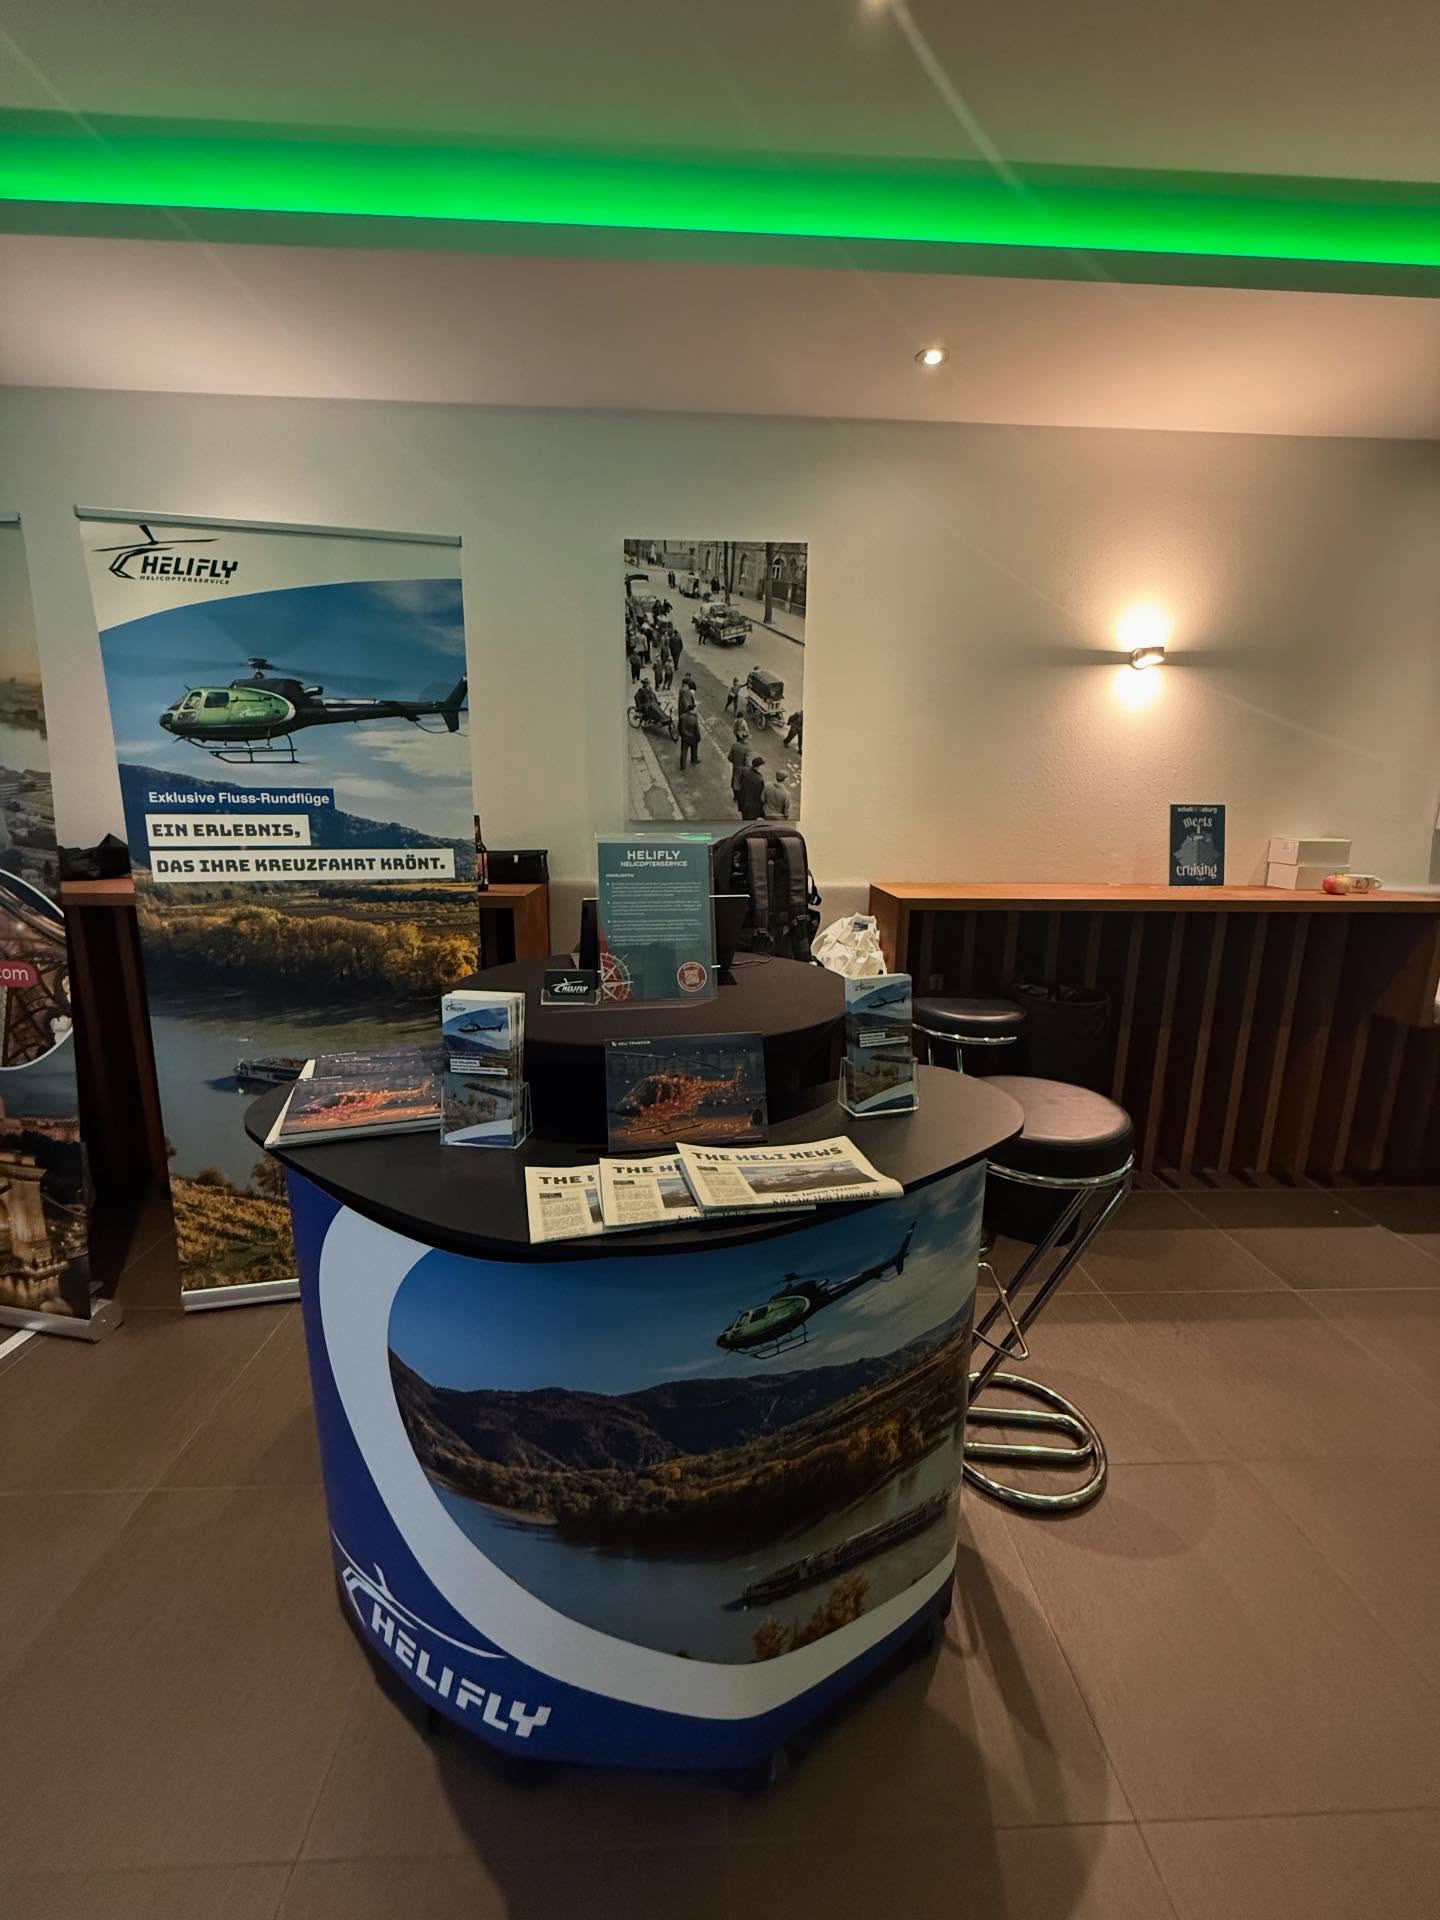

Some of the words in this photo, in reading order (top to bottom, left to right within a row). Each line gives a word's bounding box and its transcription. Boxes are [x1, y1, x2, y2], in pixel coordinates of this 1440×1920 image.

[141, 556, 238, 578] HELIFLY
[140, 576, 230, 585] HELICOPTERSERVICE
[149, 792, 215, 804] Exklusive
[218, 792, 330, 806] Fluss-Rundflüge
[152, 824, 188, 837] EIN
[193, 824, 301, 838] ERLEBNIS,
[627, 850, 680, 860] HELIFLY
[157, 859, 196, 873] DAS
[200, 859, 250, 872] IHRE
[255, 858, 376, 872] KREUZFAHRT
[381, 854, 446, 870] KRÖNT.
[1176, 863, 1218, 880] cruising
[0, 967, 29, 981] om
[691, 1152, 734, 1161] THE
[736, 1153, 786, 1161] HELI
[791, 1147, 843, 1159] NEWS
[612, 1166, 654, 1174] THE
[538, 1175, 582, 1185] THE
[371, 1601, 552, 1738] HELIFLY
